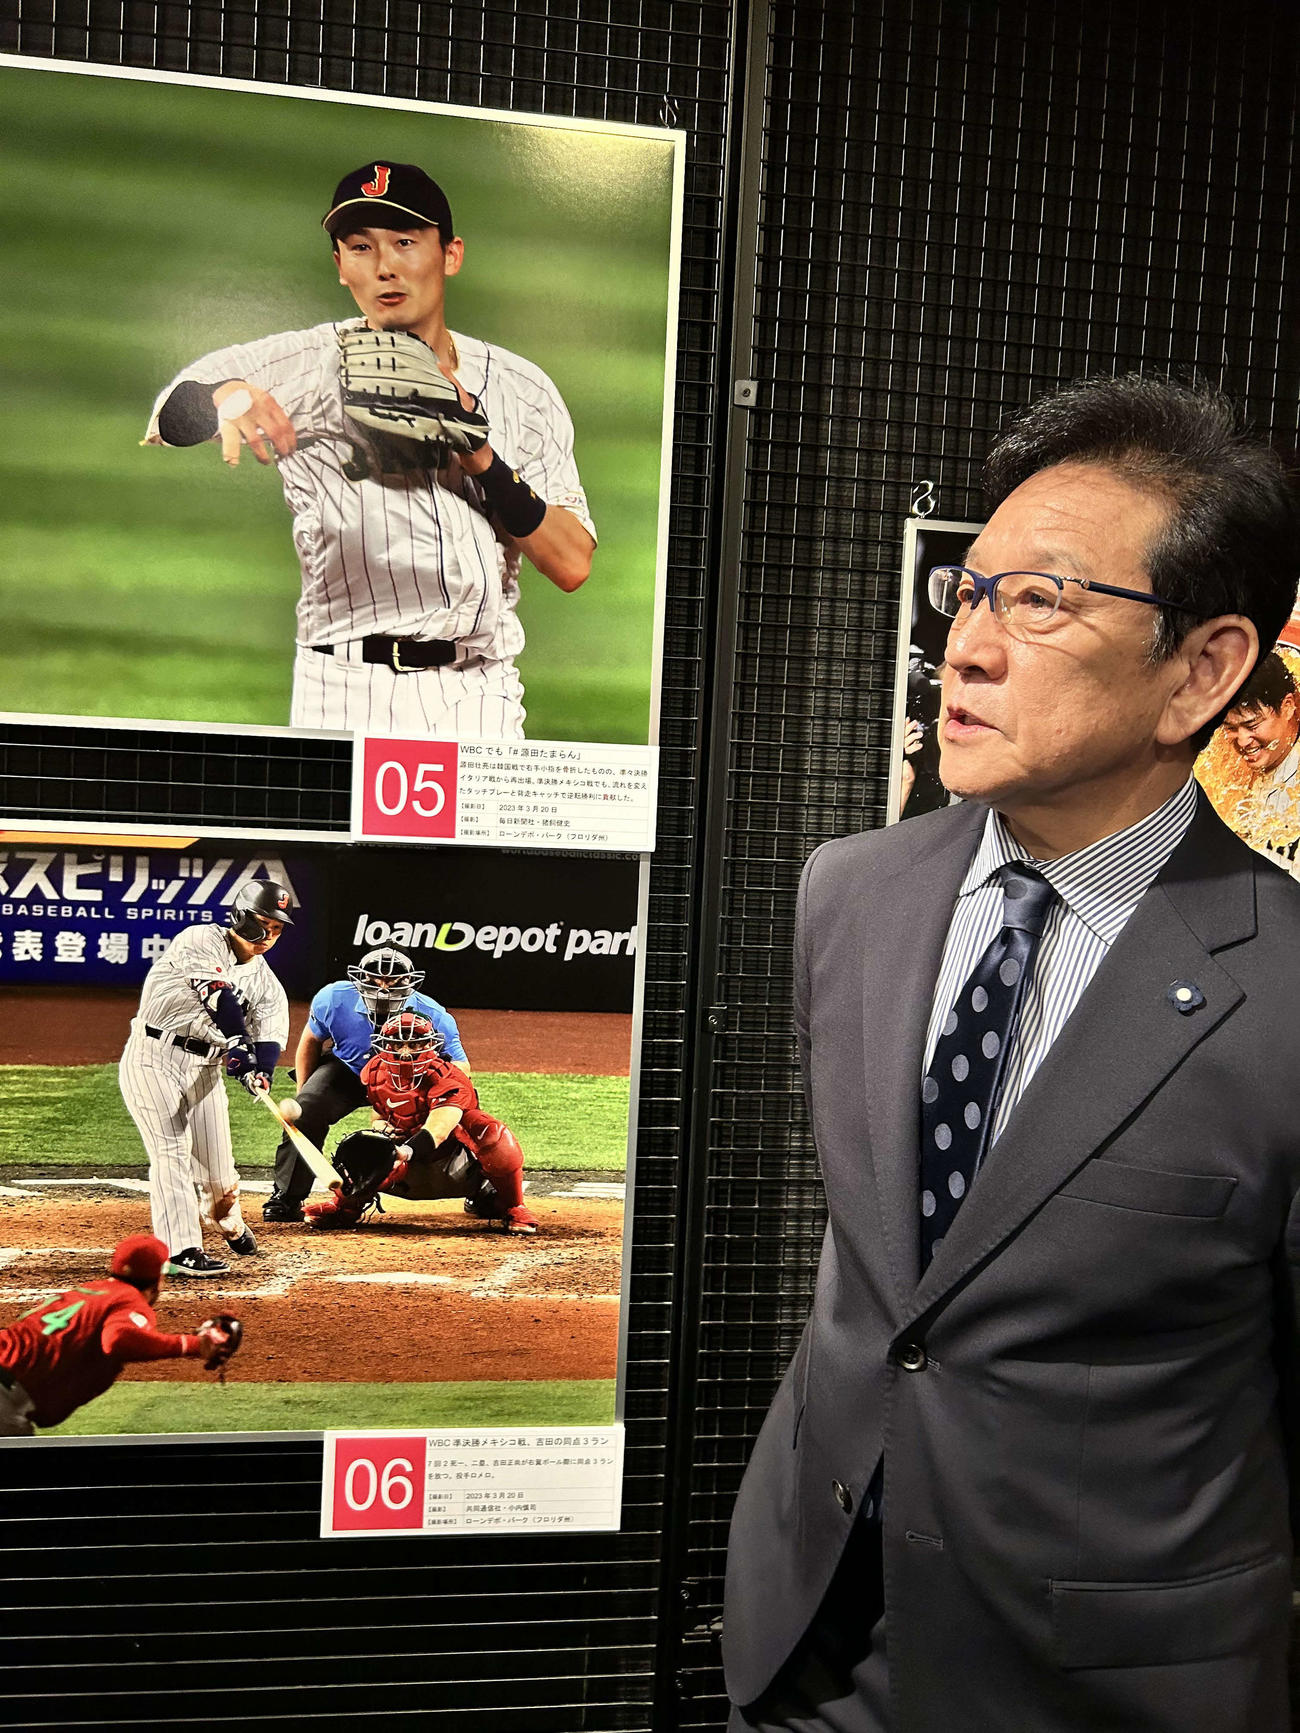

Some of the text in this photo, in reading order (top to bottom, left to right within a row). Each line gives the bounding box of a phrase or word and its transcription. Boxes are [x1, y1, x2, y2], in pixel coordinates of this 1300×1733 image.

[360, 165, 391, 197] J
[374, 760, 446, 817] 05
[2, 904, 115, 919] BASEBALL
[126, 908, 213, 922] SPIRITS
[0, 930, 172, 965] 表登場中
[353, 914, 561, 958] loanDepot
[344, 1457, 414, 1511] 06
